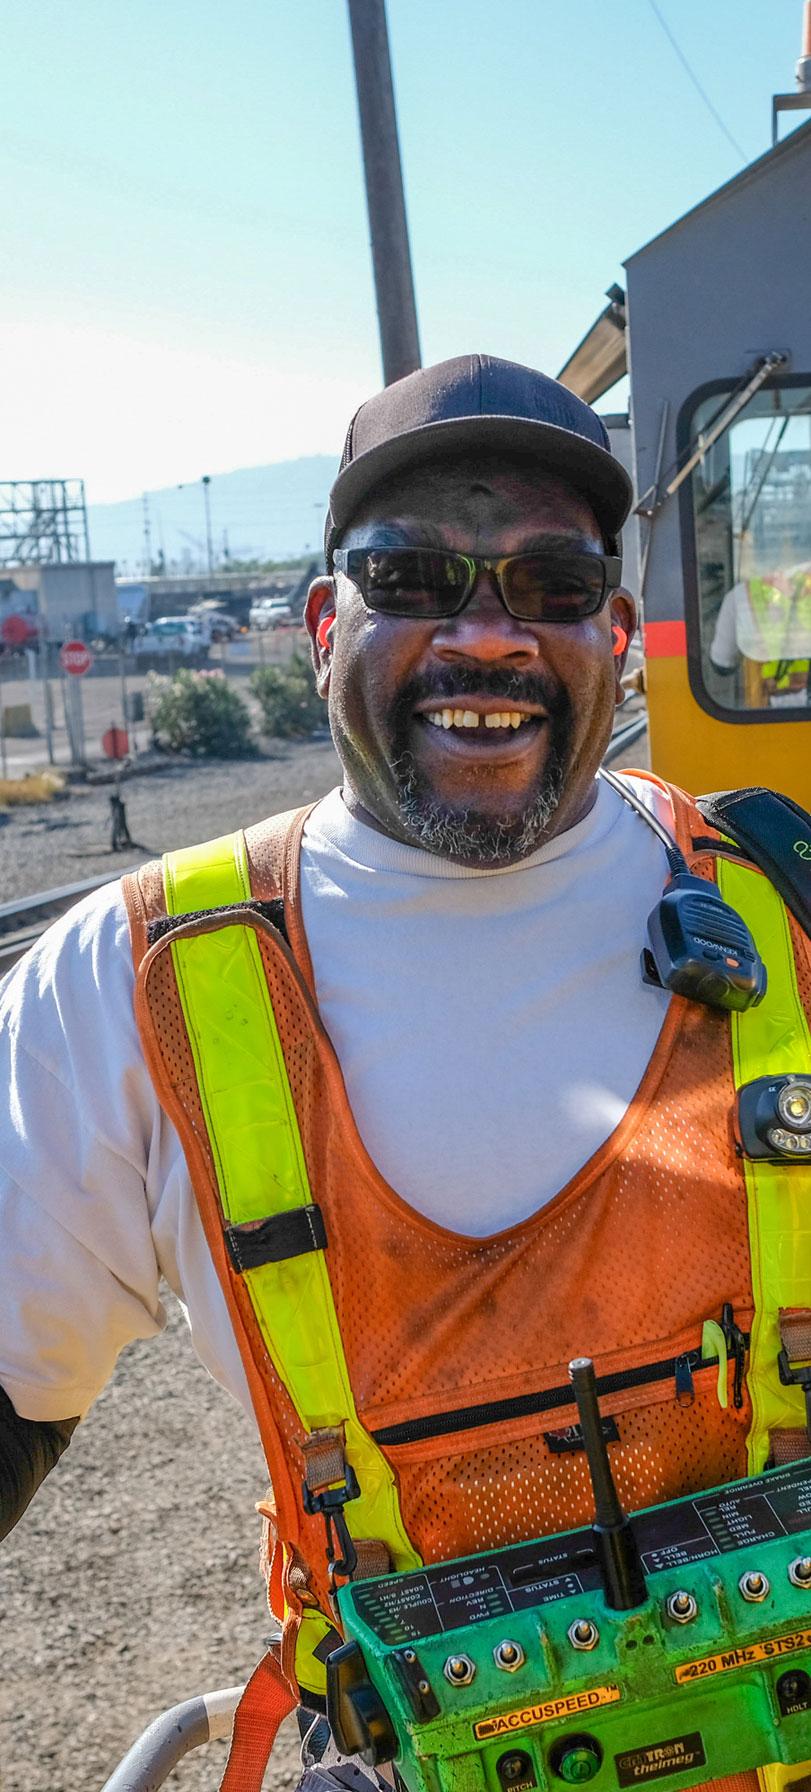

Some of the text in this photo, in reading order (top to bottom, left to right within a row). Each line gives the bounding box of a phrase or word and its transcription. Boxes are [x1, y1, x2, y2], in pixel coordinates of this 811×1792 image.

[61, 652, 89, 666] STOP
[693, 937, 738, 956] KENWOOD
[724, 1473, 791, 1494] BRAKE OVERRIDE
[718, 1499, 740, 1508] AUTO
[719, 1504, 736, 1513] REL
[722, 1511, 739, 1520] MIN
[726, 1514, 752, 1526] LIGHT
[728, 1523, 749, 1533] MED
[732, 1528, 756, 1539] FULL
[737, 1531, 775, 1546] CHARGE
[660, 1546, 678, 1556] OFF
[664, 1551, 687, 1561] BELL
[538, 1553, 568, 1565] STATUS
[666, 1549, 718, 1567] HORN/BELL
[440, 1567, 485, 1583] HEADLIGHT
[378, 1578, 404, 1588] SPEED
[525, 1580, 560, 1593] STATUS
[401, 1585, 424, 1596] COAST
[449, 1587, 494, 1604] DIRECTION
[466, 1598, 484, 1607] REV
[543, 1593, 565, 1602] TIME
[404, 1624, 414, 1632] 10
[689, 1660, 717, 1678] 220
[721, 1650, 756, 1669] MHz
[497, 1691, 600, 1731] ACCUSPEED
[786, 1701, 808, 1714] HDLT
[507, 1781, 534, 1792] PITCH
